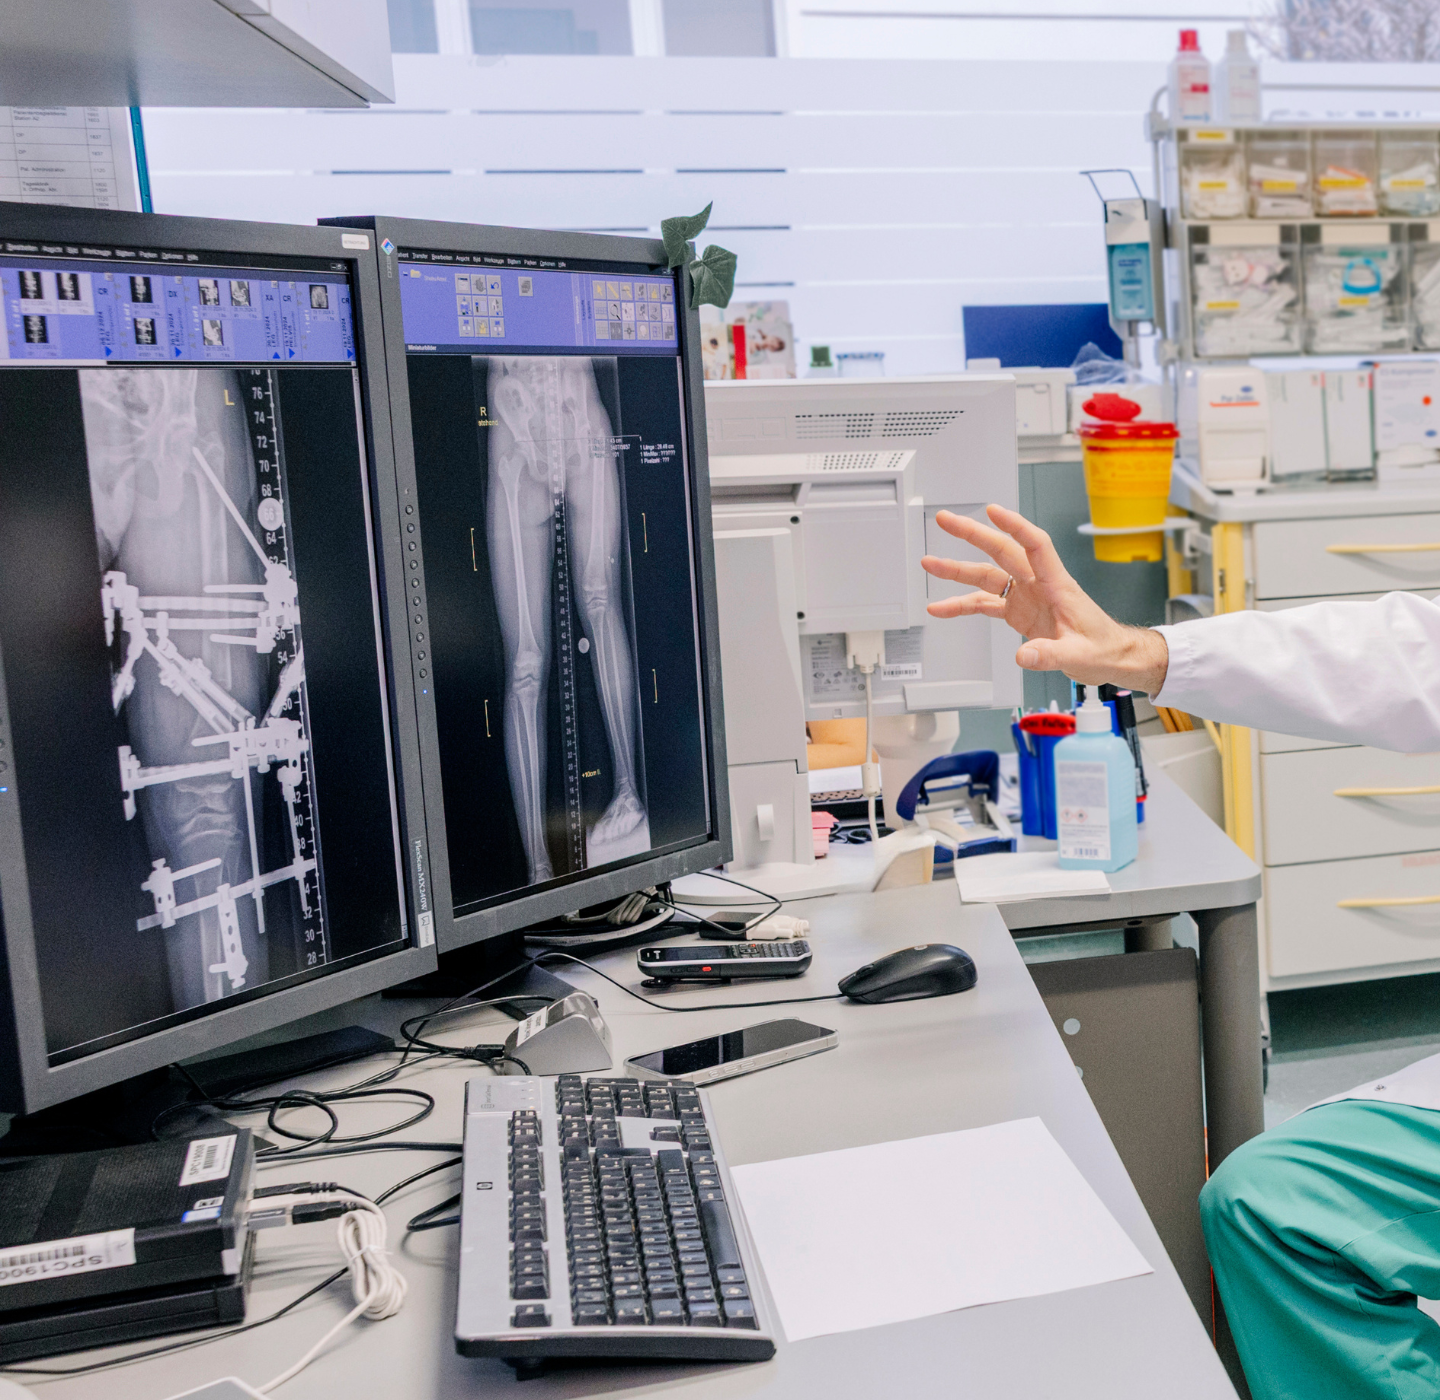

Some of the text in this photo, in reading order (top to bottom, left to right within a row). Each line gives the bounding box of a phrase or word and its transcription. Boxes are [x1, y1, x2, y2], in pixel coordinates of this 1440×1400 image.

[224, 389, 235, 405] L
[252, 386, 263, 399] 76
[254, 411, 265, 424] 74
[479, 406, 487, 416] R
[256, 436, 268, 448] 72
[259, 460, 270, 472] 70
[261, 484, 272, 497] 68
[266, 532, 277, 545] 64
[275, 630, 286, 640] 56
[277, 651, 288, 664] 54
[282, 698, 292, 711] 50
[305, 882, 311, 894] 4
[305, 930, 315, 942] 30
[307, 952, 317, 965] 28
